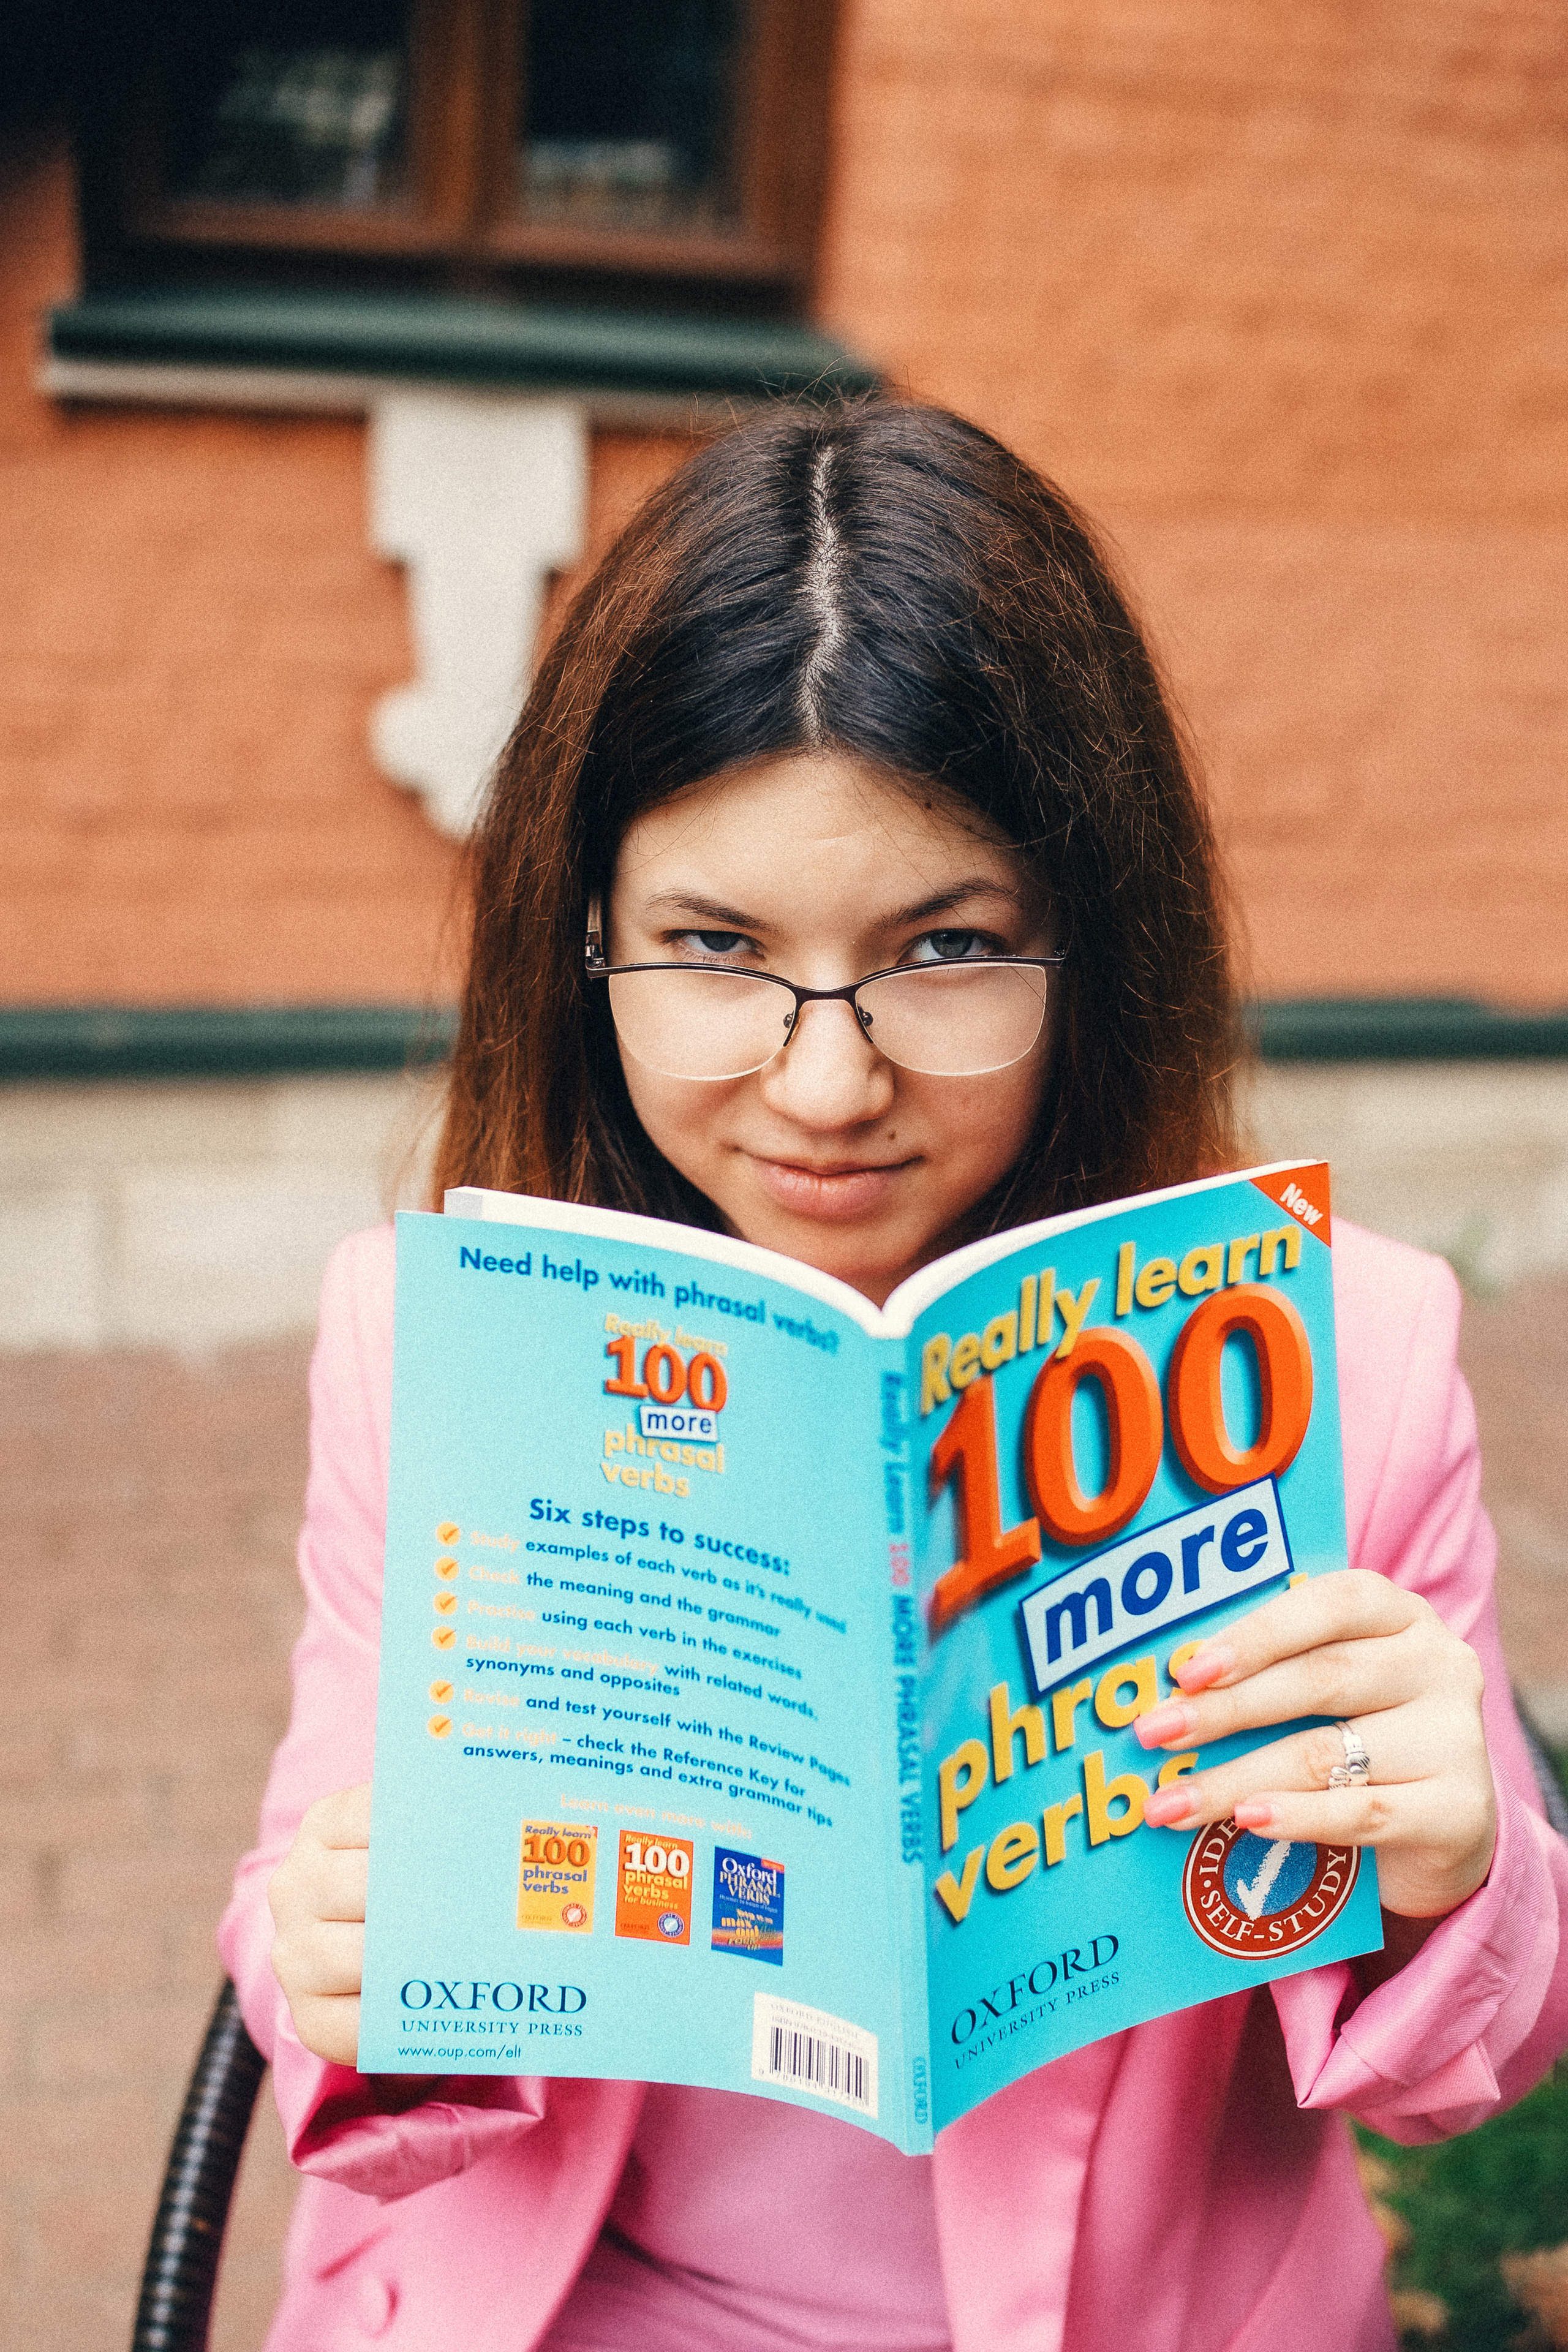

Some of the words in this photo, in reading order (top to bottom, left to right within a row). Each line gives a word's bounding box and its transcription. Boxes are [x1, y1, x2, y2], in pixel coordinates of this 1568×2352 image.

[1280, 1183, 1324, 1225] New
[460, 1247, 531, 1276] Need
[543, 1254, 599, 1291] help
[609, 1270, 665, 1298] with
[676, 1282, 765, 1324] phrasal
[605, 1313, 671, 1347] Really
[674, 1325, 728, 1357] learn
[921, 1267, 1099, 1416] Really
[1116, 1224, 1302, 1316] learn
[604, 1335, 728, 1413] 100
[647, 1412, 712, 1433] more
[604, 1423, 725, 1474] phrasal
[929, 1283, 1313, 1632] 100
[600, 1461, 690, 1498] verbs
[530, 1498, 571, 1524] Six
[582, 1509, 650, 1539] steps
[660, 1521, 684, 1544] to
[694, 1534, 790, 1577] success:
[470, 1531, 519, 1553] Study
[526, 1541, 608, 1561] examples
[615, 1551, 631, 1565] of
[638, 1558, 675, 1574] each
[682, 1567, 717, 1585] verb
[723, 1577, 741, 1591] as
[469, 1566, 519, 1584] Check
[527, 1572, 553, 1588] the
[560, 1580, 633, 1604] meaning
[639, 1593, 671, 1608] and
[677, 1597, 703, 1615] the
[708, 1608, 780, 1637] grammar
[1046, 1507, 1269, 1665] more
[468, 1600, 536, 1621] Practise
[542, 1610, 587, 1630] using
[594, 1619, 633, 1634] each
[639, 1627, 676, 1643] verb
[682, 1631, 697, 1648] in
[702, 1637, 728, 1656] the
[733, 1648, 802, 1681] exercises
[466, 1634, 510, 1653] Build
[516, 1642, 557, 1657] your
[562, 1649, 659, 1676] vocabulary
[665, 1664, 700, 1682] with
[707, 1673, 763, 1699] related
[466, 1657, 555, 1676] synonyms
[560, 1667, 594, 1681] and
[600, 1673, 680, 1696] opposites
[464, 1687, 520, 1707] Revise
[526, 1697, 560, 1711] and
[566, 1700, 597, 1715] test
[603, 1706, 672, 1728] yourself
[677, 1719, 713, 1736] with
[718, 1726, 743, 1745] the
[749, 1734, 804, 1764] Review
[897, 1674, 919, 1785] PHRASAL
[462, 1722, 492, 1740] Get
[499, 1725, 510, 1740] it
[516, 1727, 557, 1747] right
[577, 1734, 624, 1754] check
[631, 1742, 657, 1758] the
[663, 1747, 744, 1777] Reference
[749, 1767, 779, 1791] Key
[784, 1778, 806, 1798] for
[463, 1746, 544, 1764] answers,
[550, 1753, 634, 1775] meanings
[639, 1765, 673, 1780] and
[678, 1771, 723, 1791] extra
[728, 1784, 802, 1814] grammar
[807, 1806, 833, 1828] tips
[525, 1825, 560, 1837] Really
[562, 1828, 592, 1839] learn
[560, 1794, 609, 1812] Learn
[614, 1803, 656, 1819] even
[661, 1811, 705, 1828] more
[900, 1791, 922, 1864] VERBS
[523, 1834, 591, 1867] 100
[624, 1842, 690, 1878] 100
[625, 1834, 654, 1847] Really
[654, 1838, 678, 1850] learn
[1199, 1817, 1240, 1876] IDE
[523, 1865, 587, 1882] phrasal
[523, 1879, 569, 1894] verbs
[623, 1883, 669, 1899] verbs
[625, 1869, 688, 1890] phrasal
[719, 1871, 780, 1898] PHRASAL
[722, 1857, 777, 1885] Oxford
[624, 1894, 638, 1903] for
[639, 1896, 678, 1910] business
[728, 1884, 770, 1905] VERBS
[1200, 1849, 1347, 1942] SELF-STUDY
[400, 1980, 587, 2013] OXFORD
[951, 1934, 1120, 2045] OXFORD
[402, 2020, 519, 2035] UNIVERSITY
[528, 2022, 582, 2037] PRESS
[956, 1999, 1057, 2070] UNIVERSITY
[1066, 1971, 1120, 2003] PRESS
[398, 2045, 522, 2060] www.oup.com/elt
